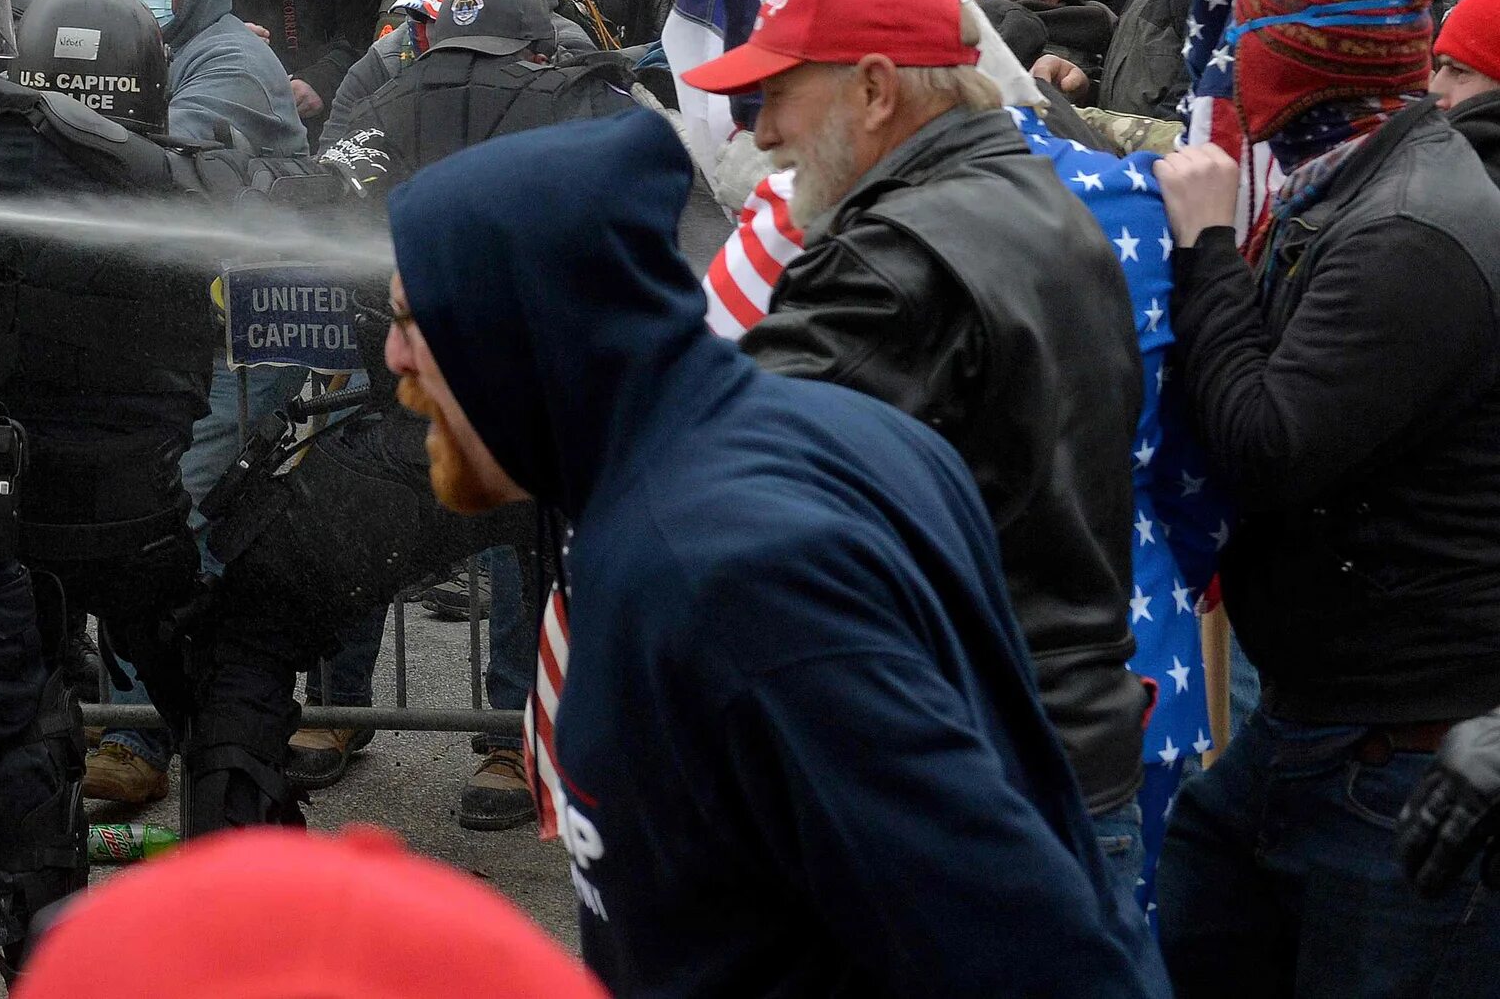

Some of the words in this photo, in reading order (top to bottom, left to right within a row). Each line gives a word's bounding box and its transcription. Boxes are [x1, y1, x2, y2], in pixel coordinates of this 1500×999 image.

[59, 36, 82, 47] Weber
[20, 70, 51, 88] U.S.
[56, 73, 141, 93] CAPITOL
[252, 287, 348, 312] UNITED
[248, 323, 357, 349] CAPITOL
